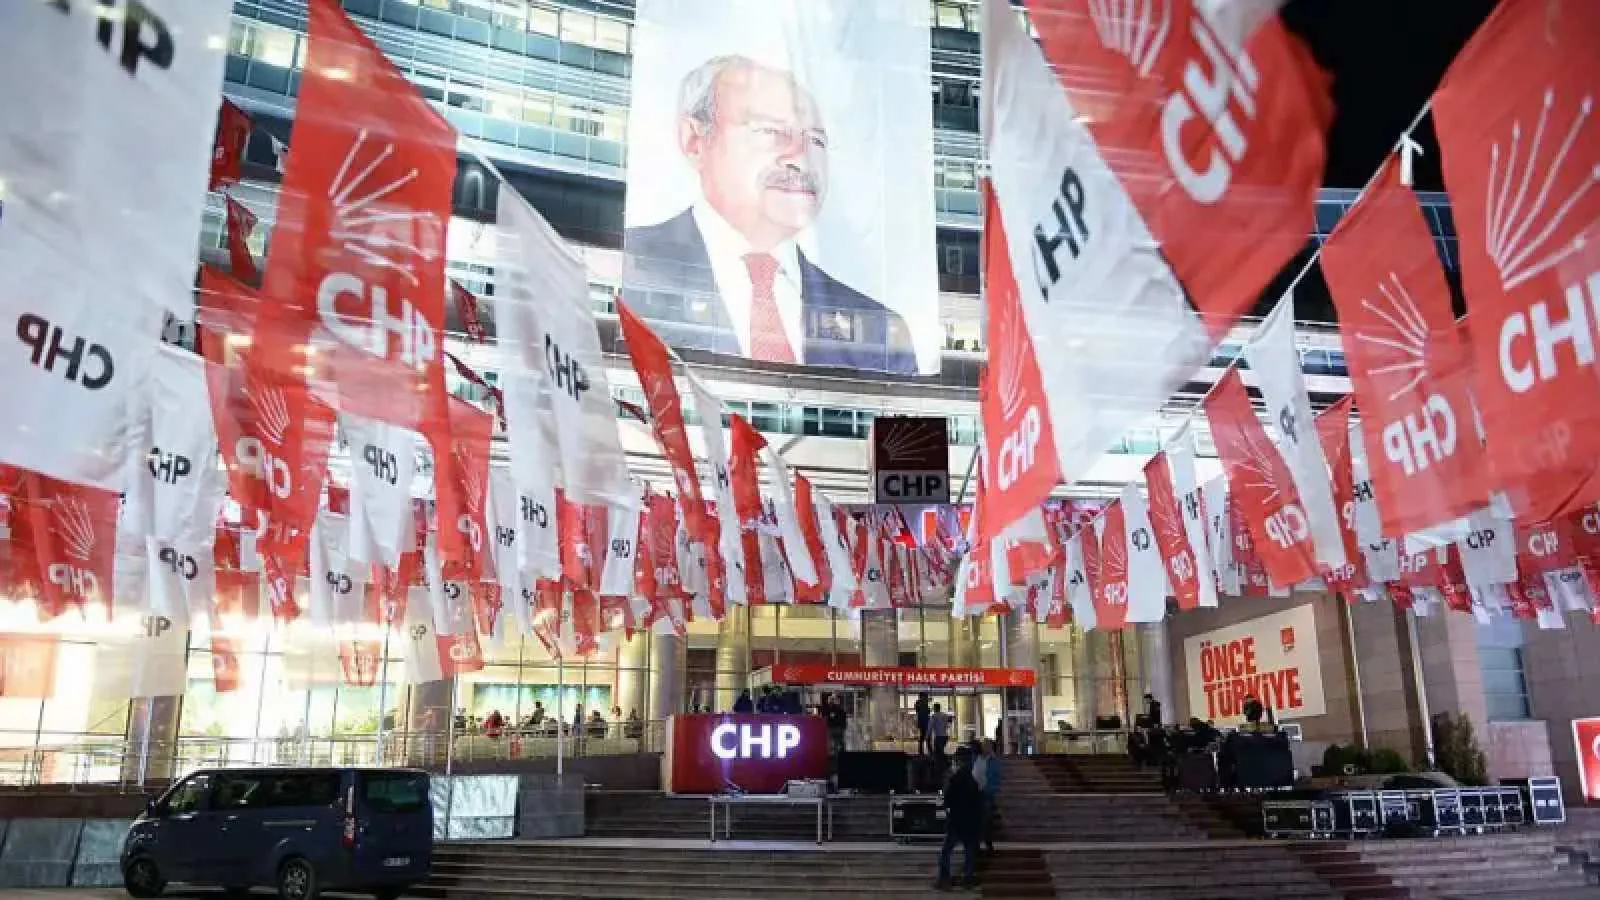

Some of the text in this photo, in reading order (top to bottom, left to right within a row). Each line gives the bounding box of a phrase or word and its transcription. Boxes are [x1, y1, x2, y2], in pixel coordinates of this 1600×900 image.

[1161, 12, 1259, 204] CH
[1498, 270, 1600, 393] CH
[998, 405, 1041, 491] CHP
[883, 474, 943, 497] CHP
[1400, 553, 1427, 573] HP
[907, 671, 937, 682] HALK
[1200, 637, 1257, 682] ÖNCE
[710, 723, 801, 760] CHP
